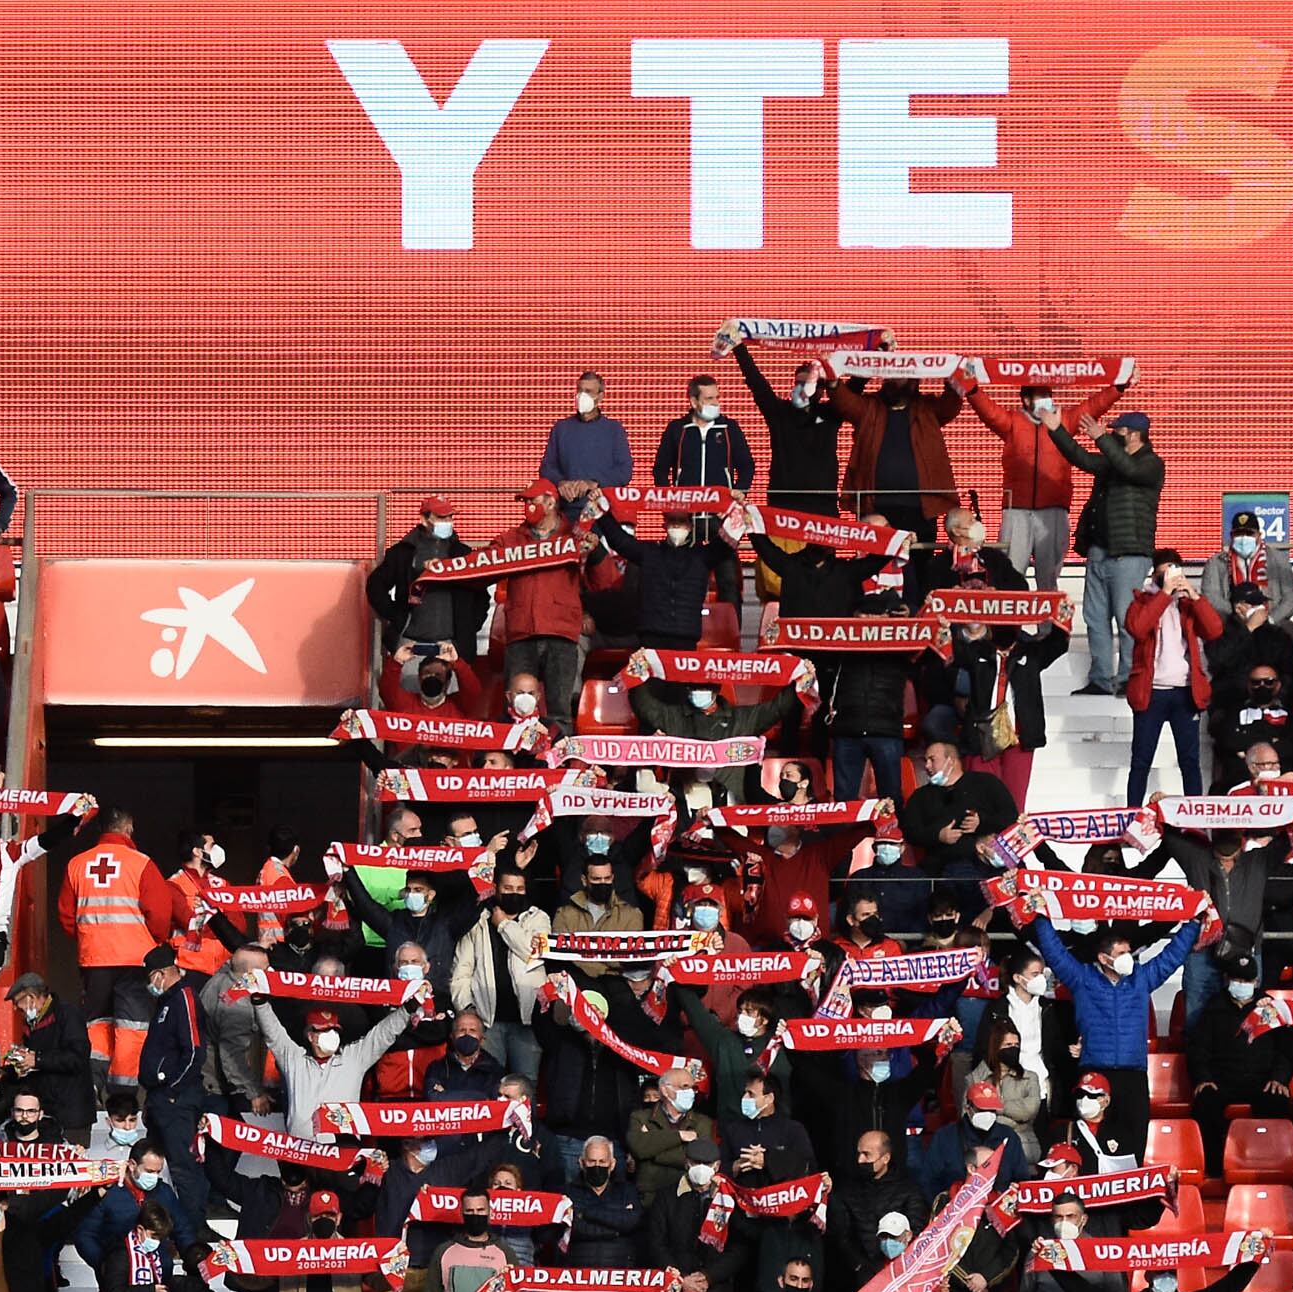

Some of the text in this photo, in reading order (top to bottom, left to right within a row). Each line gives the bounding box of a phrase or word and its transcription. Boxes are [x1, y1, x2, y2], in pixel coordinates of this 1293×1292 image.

[324, 39, 550, 248] Y
[999, 361, 1105, 377] UD ALMERÍA
[1254, 506, 1285, 517] Sector
[786, 623, 933, 641] U.D.ALMERÍA
[675, 658, 781, 675] UD ALMERÍA
[593, 740, 621, 760] UD
[436, 773, 546, 790] UD ALMERÍA
[379, 1106, 491, 1124] UD ALMERÍA
[413, 1122, 462, 1131] 2001-2021
[264, 1244, 378, 1261] UD ALMERÍA
[297, 1260, 347, 1269] 2001-2021
